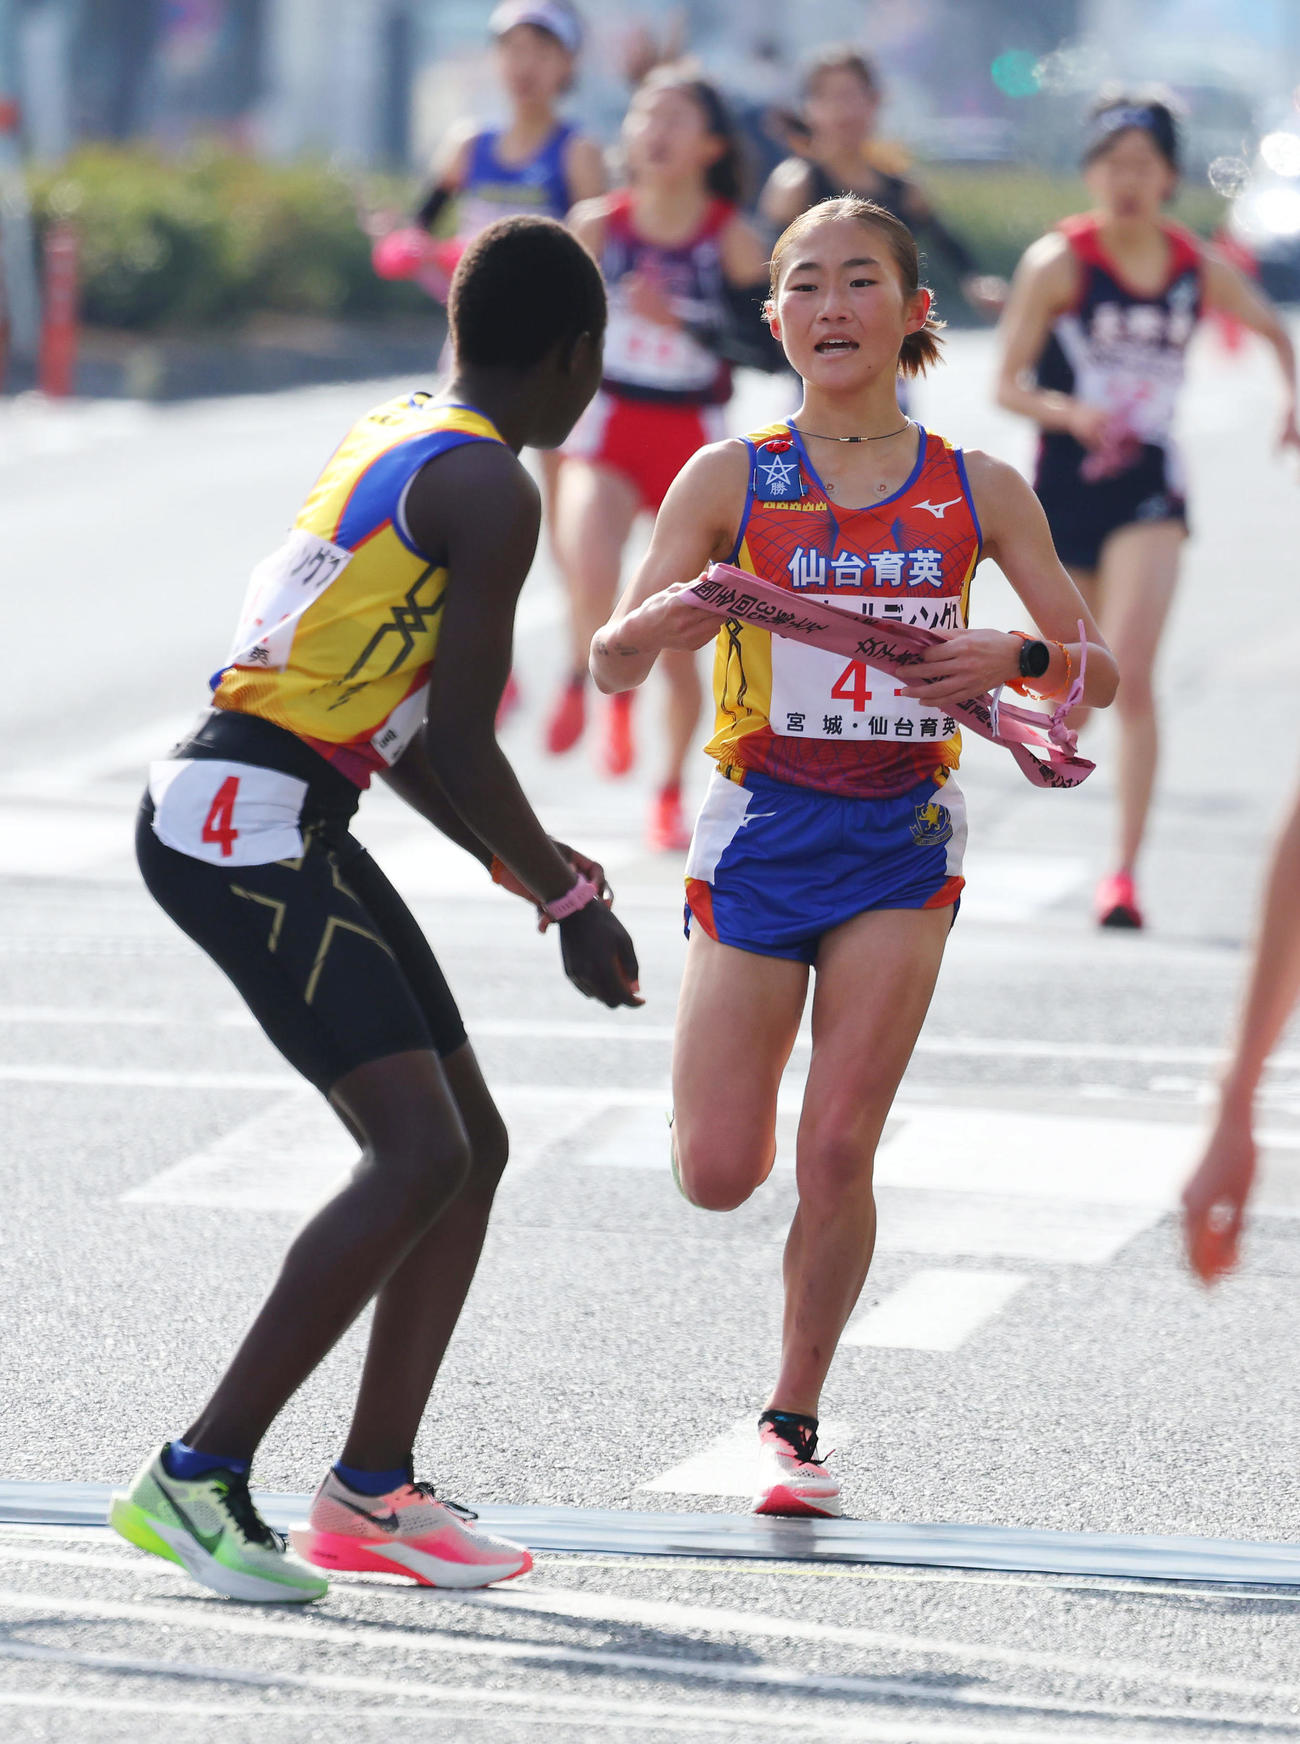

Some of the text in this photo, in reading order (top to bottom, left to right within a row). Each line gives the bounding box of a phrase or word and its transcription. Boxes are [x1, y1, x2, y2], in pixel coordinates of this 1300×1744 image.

[769, 481, 788, 496] 勝
[787, 546, 943, 588] 仙台育英
[202, 775, 241, 858] 4
